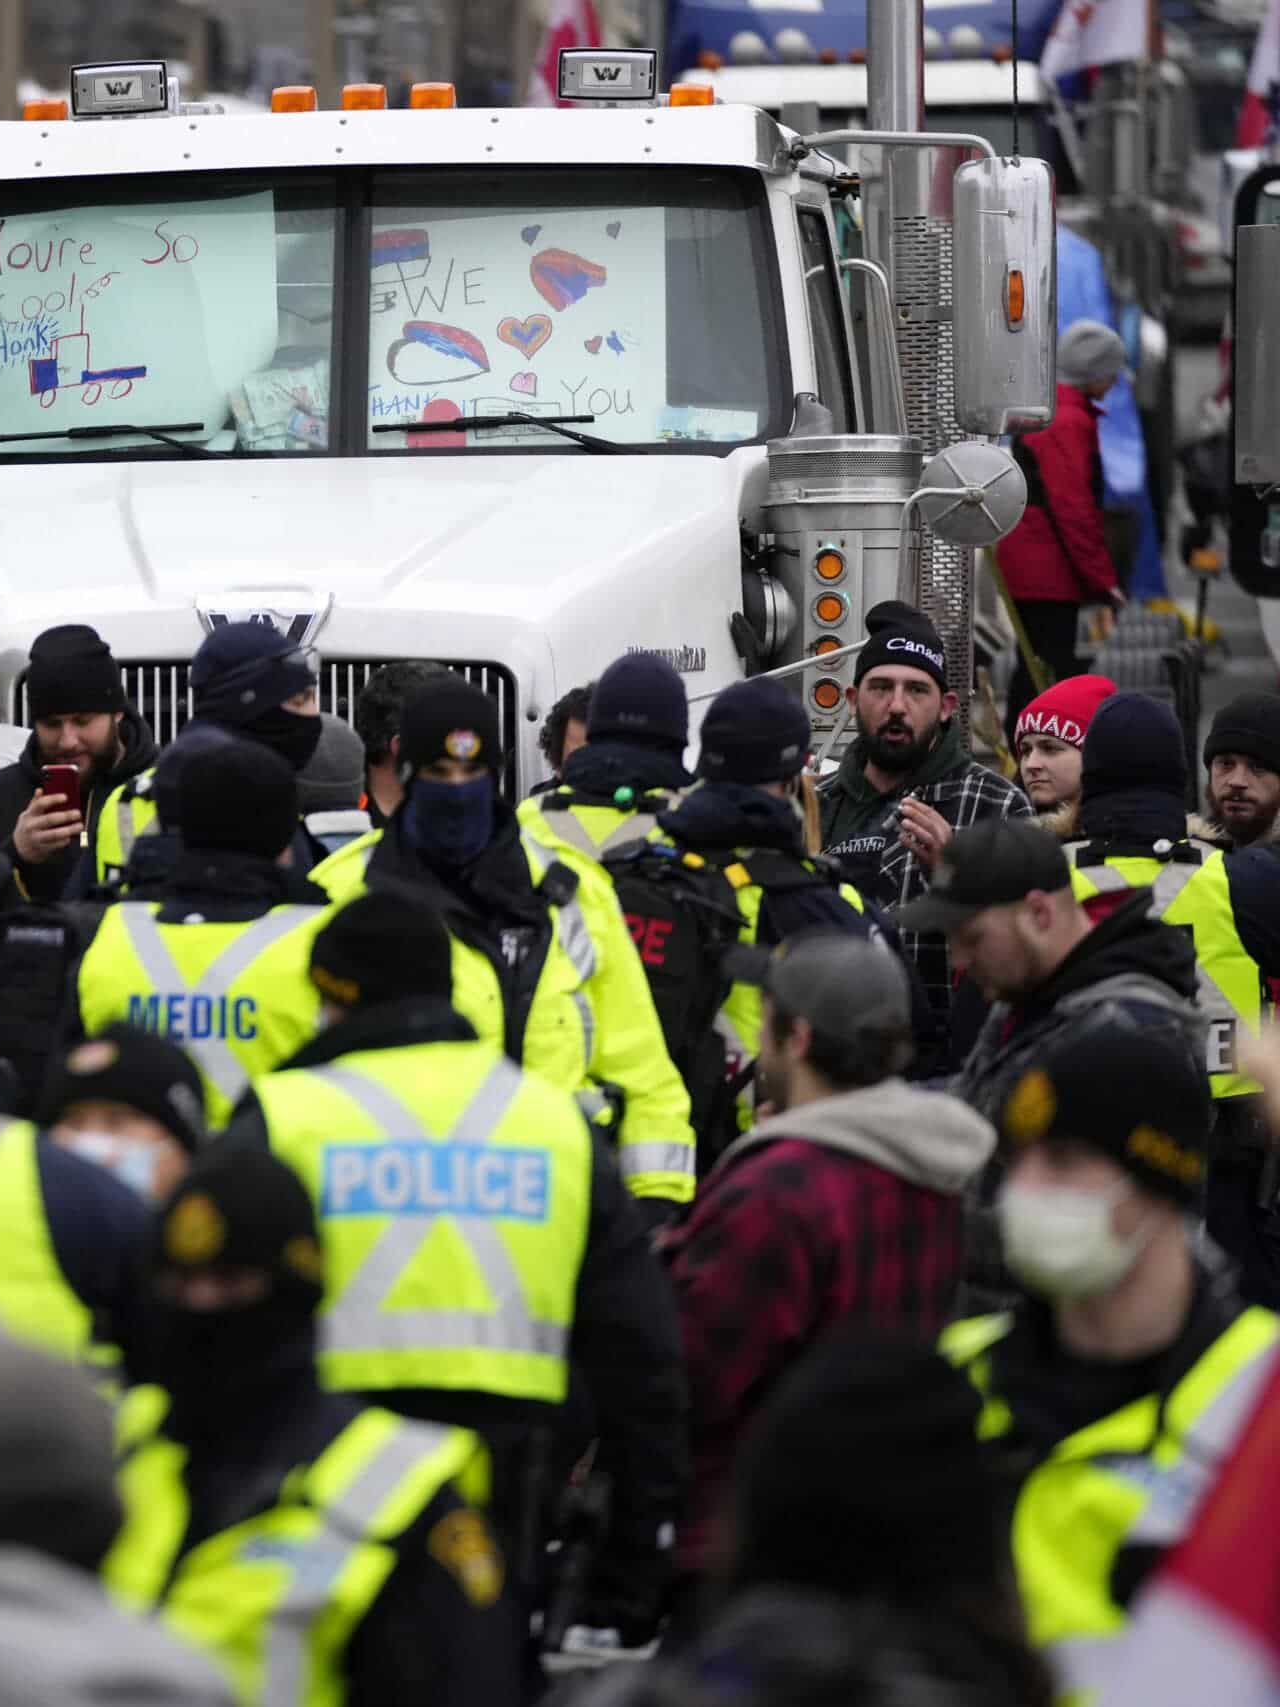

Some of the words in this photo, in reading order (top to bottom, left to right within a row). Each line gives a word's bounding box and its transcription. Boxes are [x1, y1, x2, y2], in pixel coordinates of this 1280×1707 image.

[396, 258, 486, 317] WE
[1015, 711, 1087, 747] ANAD
[129, 994, 257, 1040] MEDIC
[331, 1150, 546, 1213] POLICE
